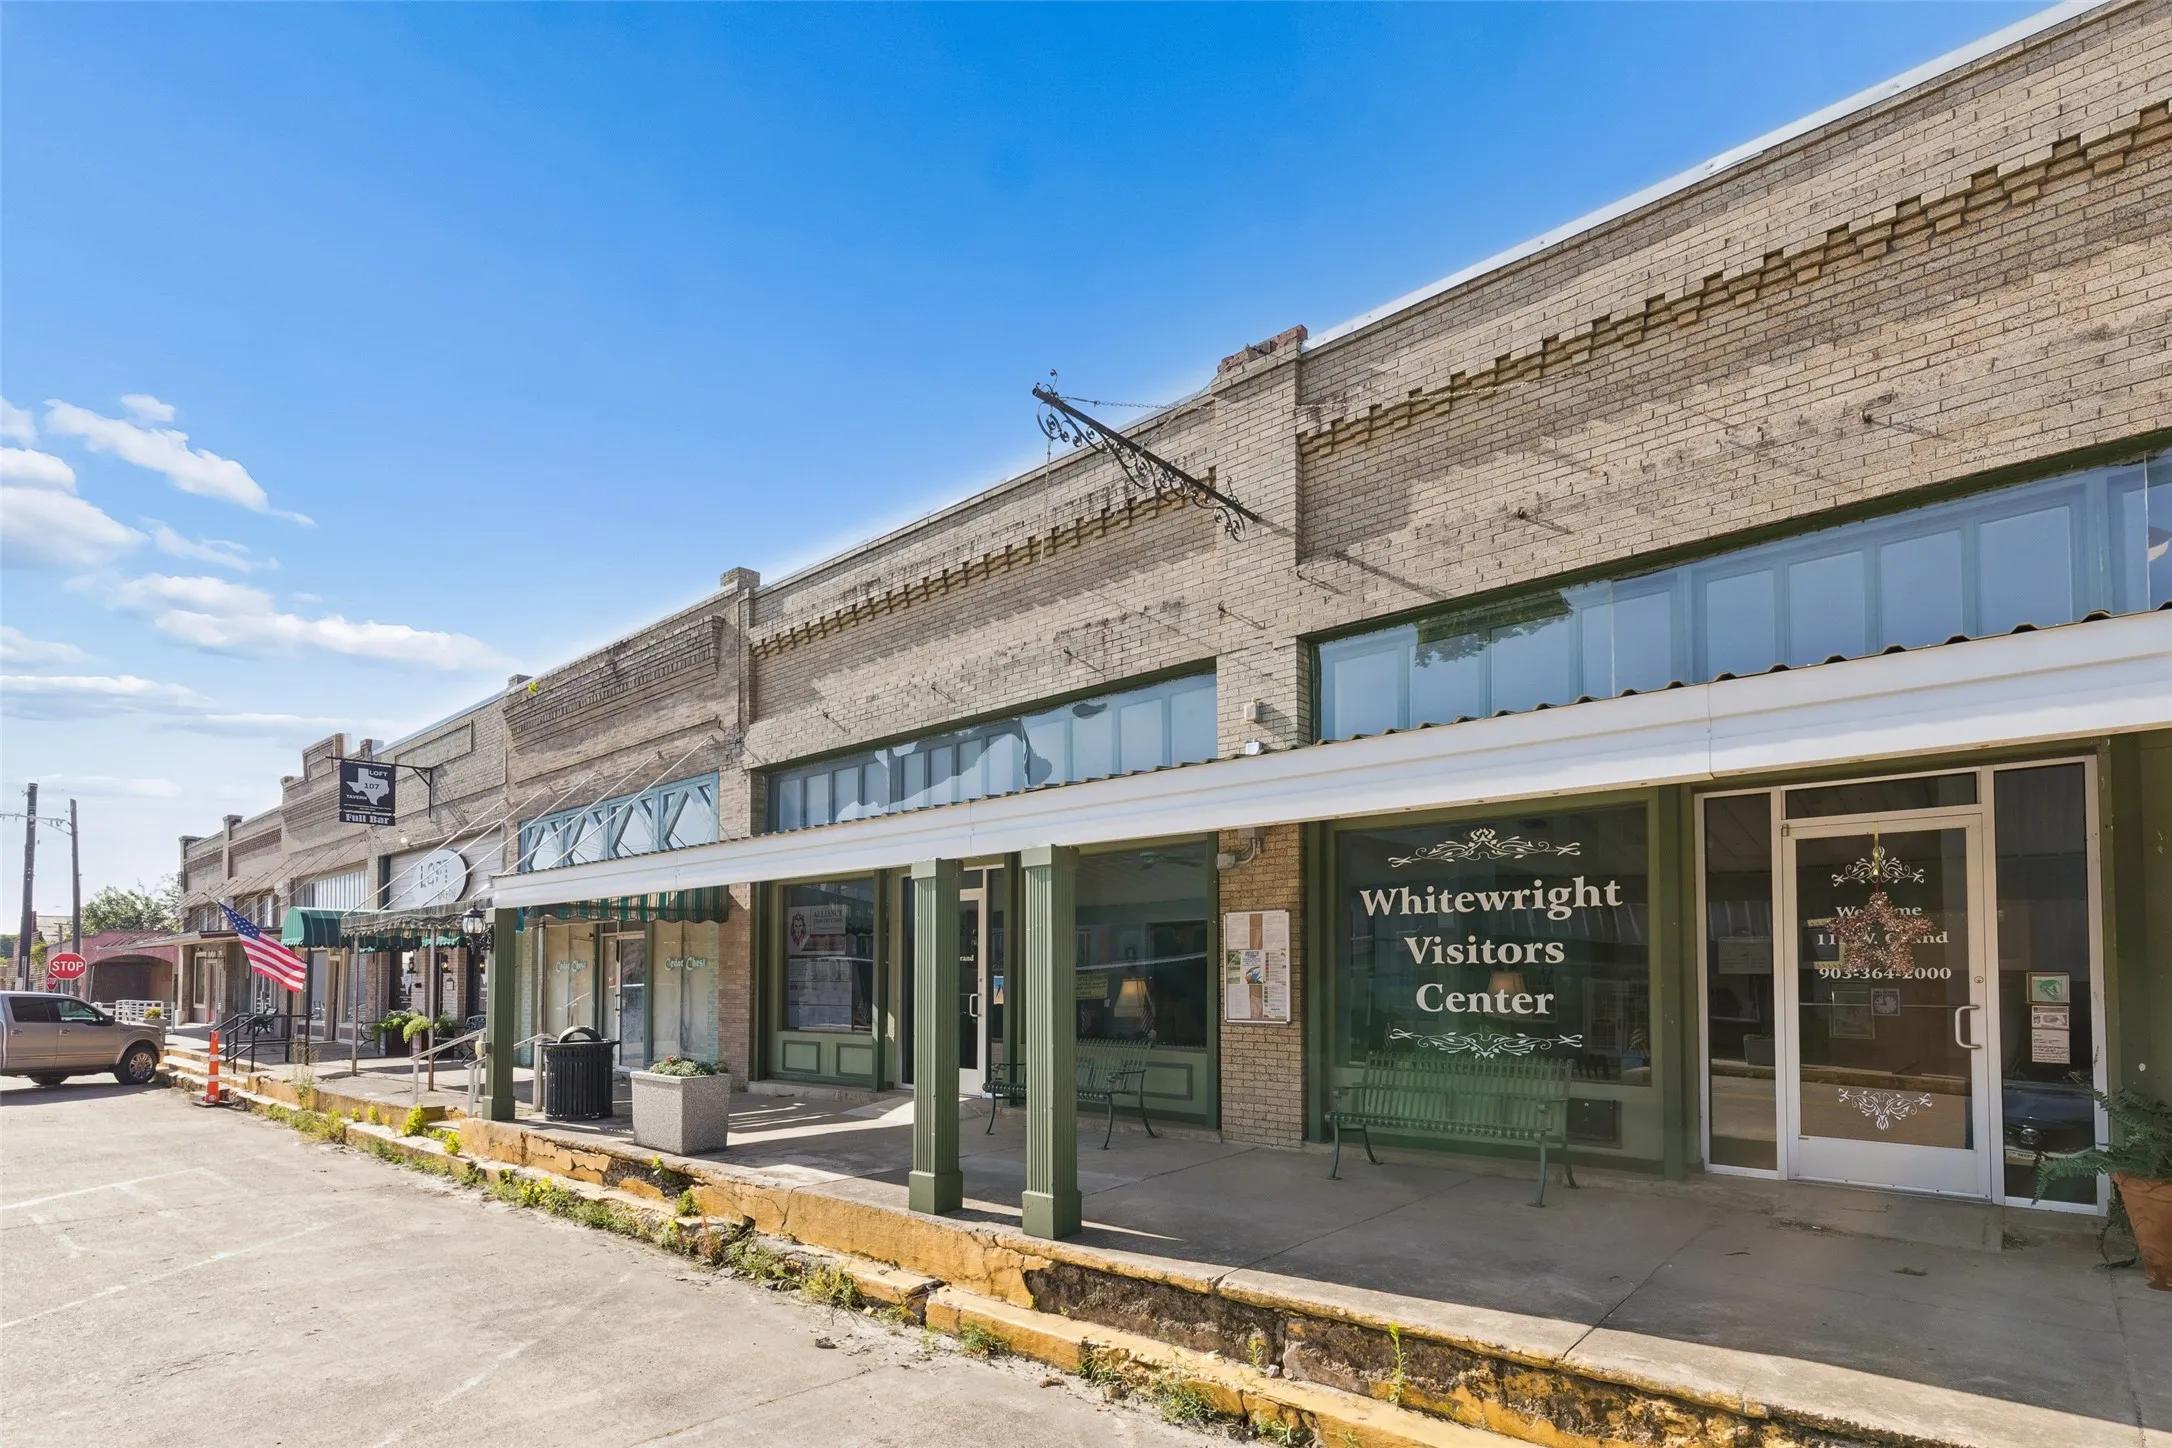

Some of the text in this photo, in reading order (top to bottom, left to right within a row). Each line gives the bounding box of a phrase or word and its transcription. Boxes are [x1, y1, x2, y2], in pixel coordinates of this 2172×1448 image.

[364, 782, 380, 790] 107
[345, 813, 390, 825] Full Bar
[1359, 875, 1624, 921] Whitewright
[1835, 905, 1923, 918] Weme
[1403, 935, 1565, 965] Visitors
[51, 961, 84, 972] STOP
[555, 960, 587, 973] Cedar Chest
[664, 956, 706, 971] Cedar Chest
[1415, 983, 1555, 1015] Center
